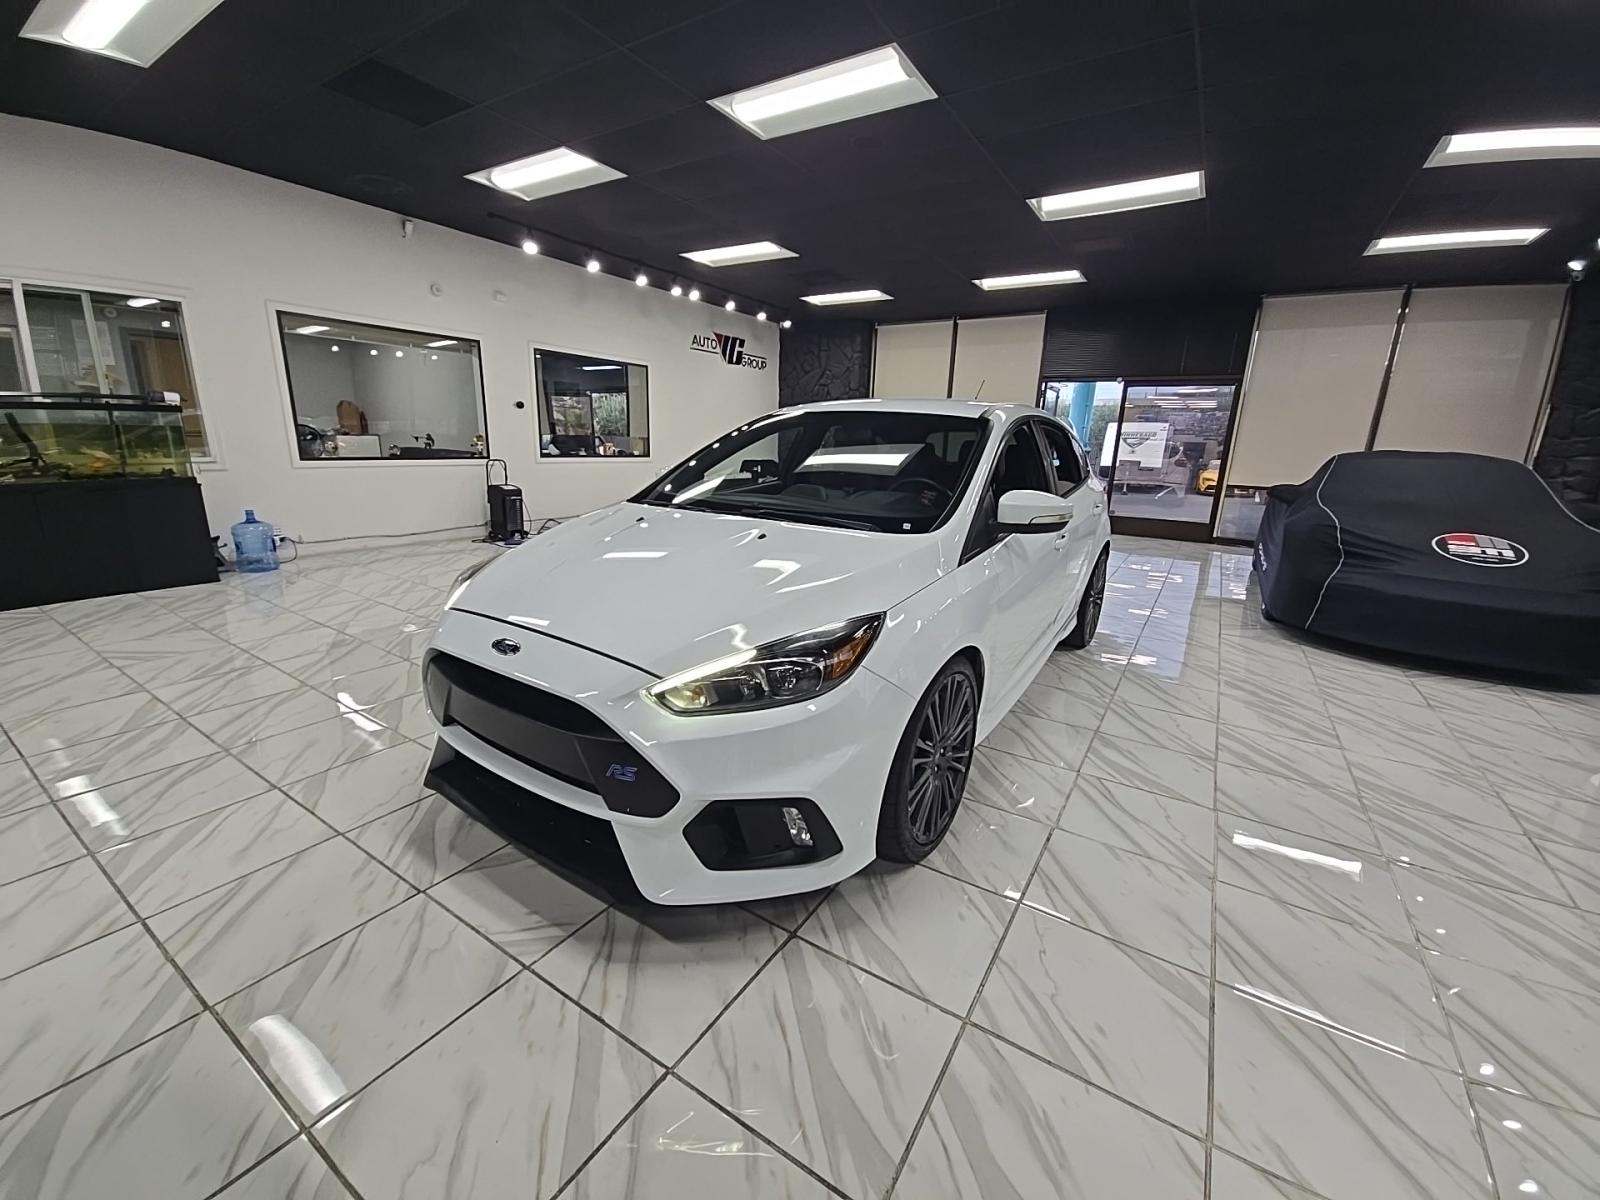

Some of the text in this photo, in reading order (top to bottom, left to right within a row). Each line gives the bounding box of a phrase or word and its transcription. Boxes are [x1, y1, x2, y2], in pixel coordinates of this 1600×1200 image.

[691, 334, 718, 350] AUTO
[741, 356, 768, 371] GROUP
[605, 763, 638, 783] RS
